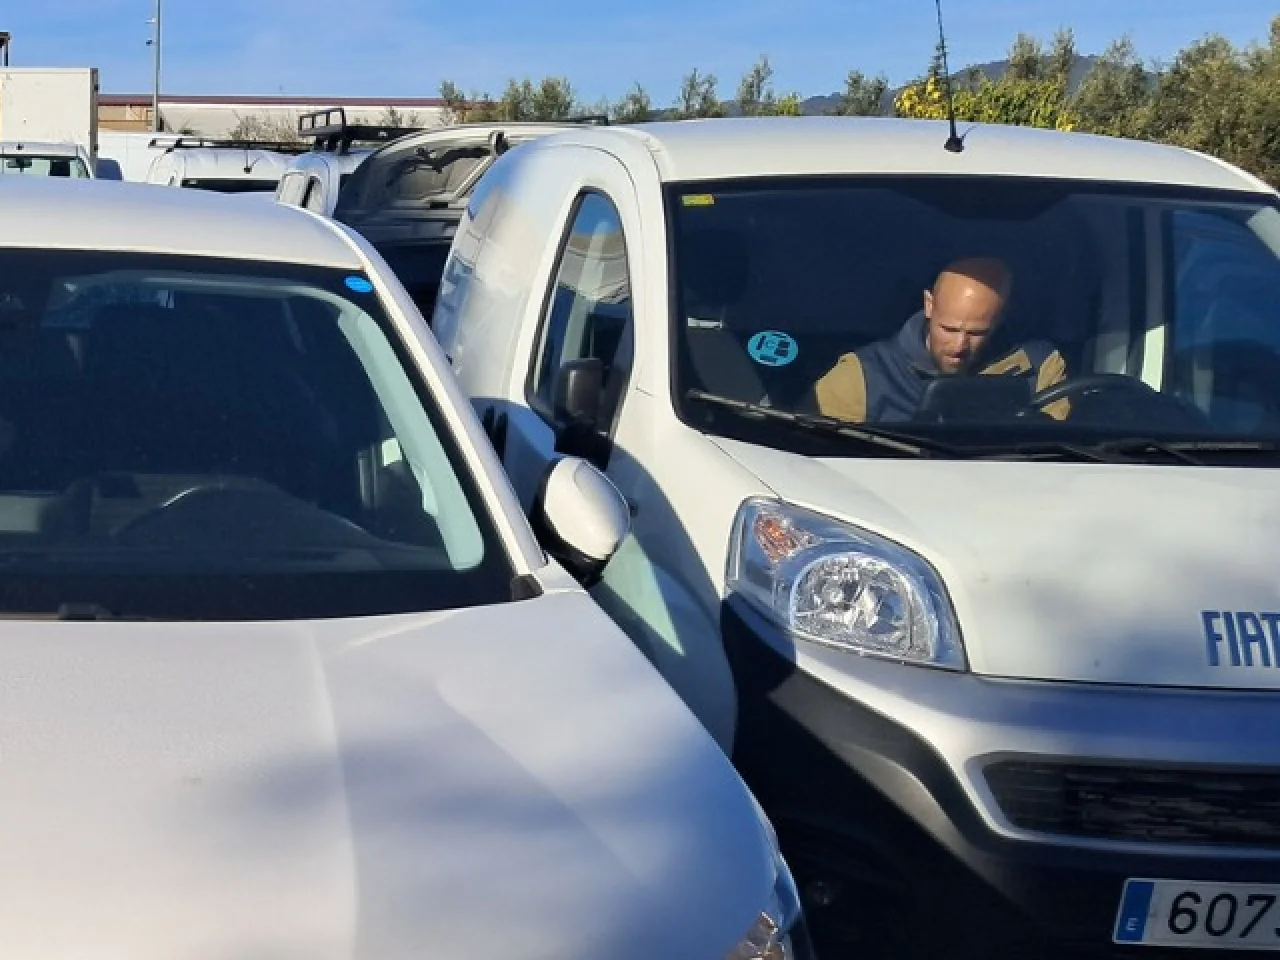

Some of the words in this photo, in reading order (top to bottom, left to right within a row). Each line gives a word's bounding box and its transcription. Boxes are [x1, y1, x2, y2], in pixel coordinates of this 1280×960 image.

[1201, 611, 1280, 668] FIAT
[1126, 917, 1139, 931] E
[1168, 891, 1280, 938] 607
